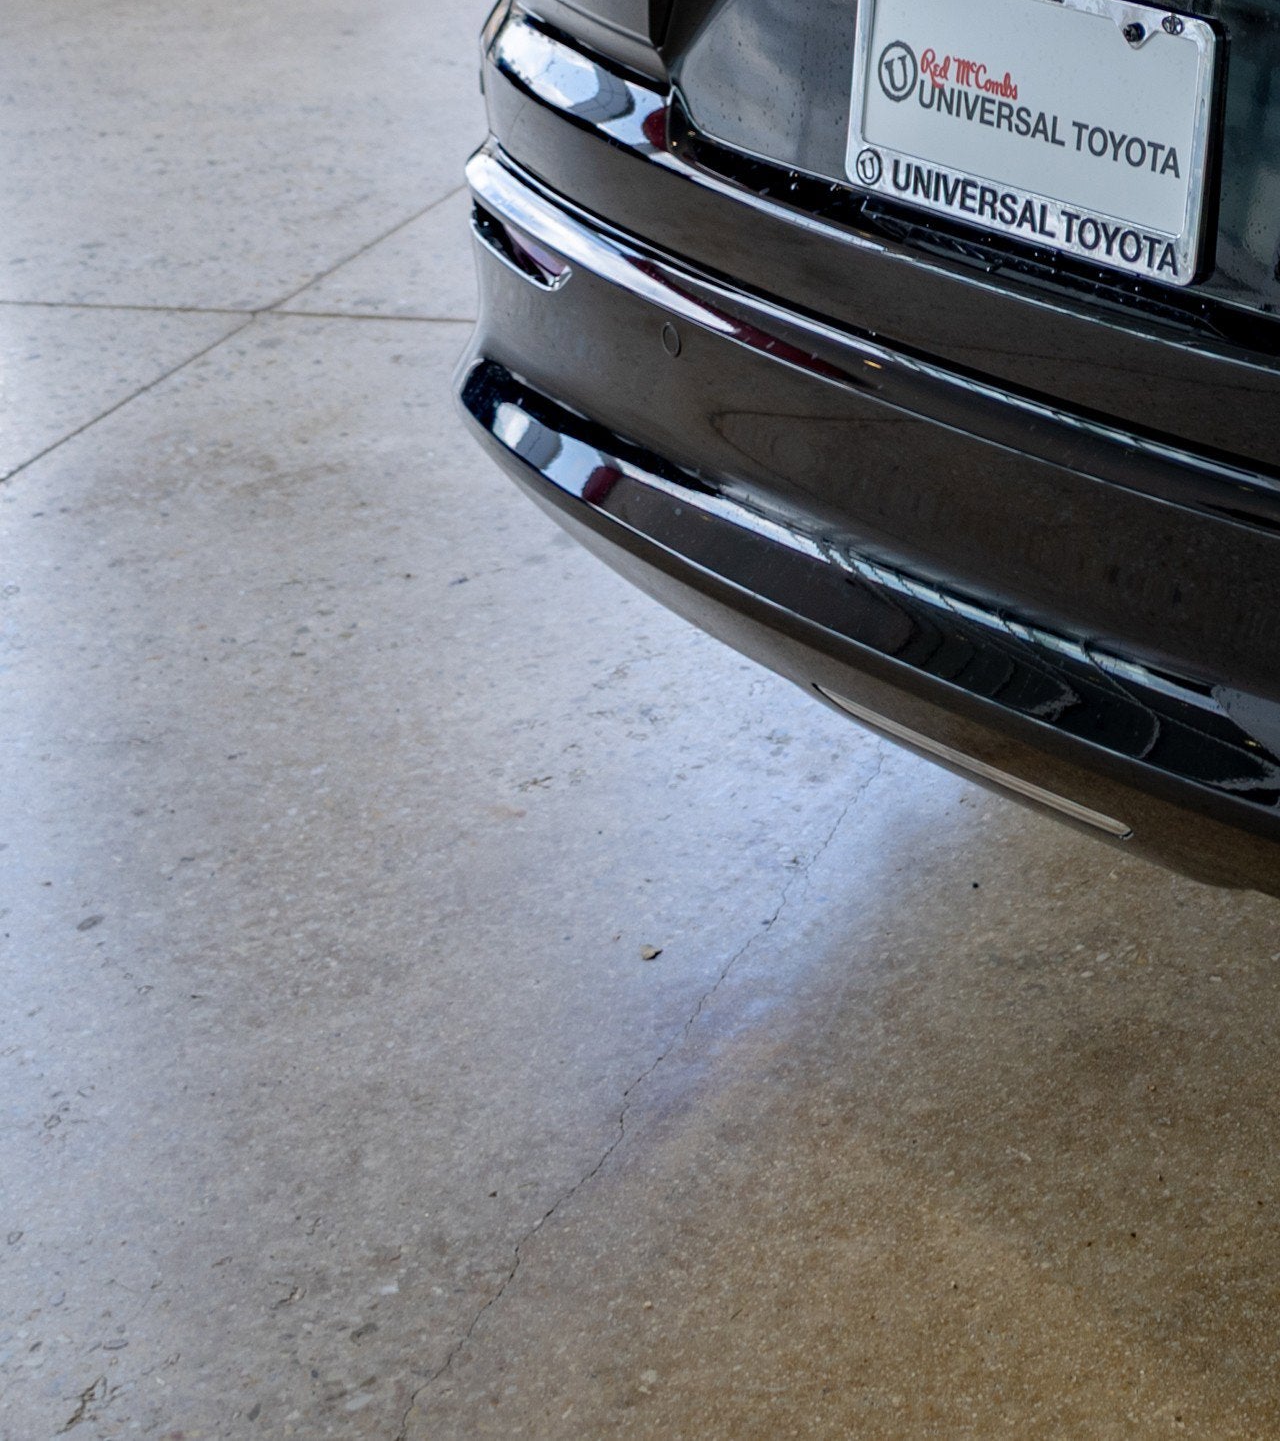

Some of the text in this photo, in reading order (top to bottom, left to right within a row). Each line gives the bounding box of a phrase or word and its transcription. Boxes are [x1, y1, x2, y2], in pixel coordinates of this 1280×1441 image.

[920, 48, 1018, 100] Red McCombs
[918, 79, 1181, 179] UNIVERSAL TOYOTA
[892, 159, 1179, 277] UNIVERSAL TOYOTA
